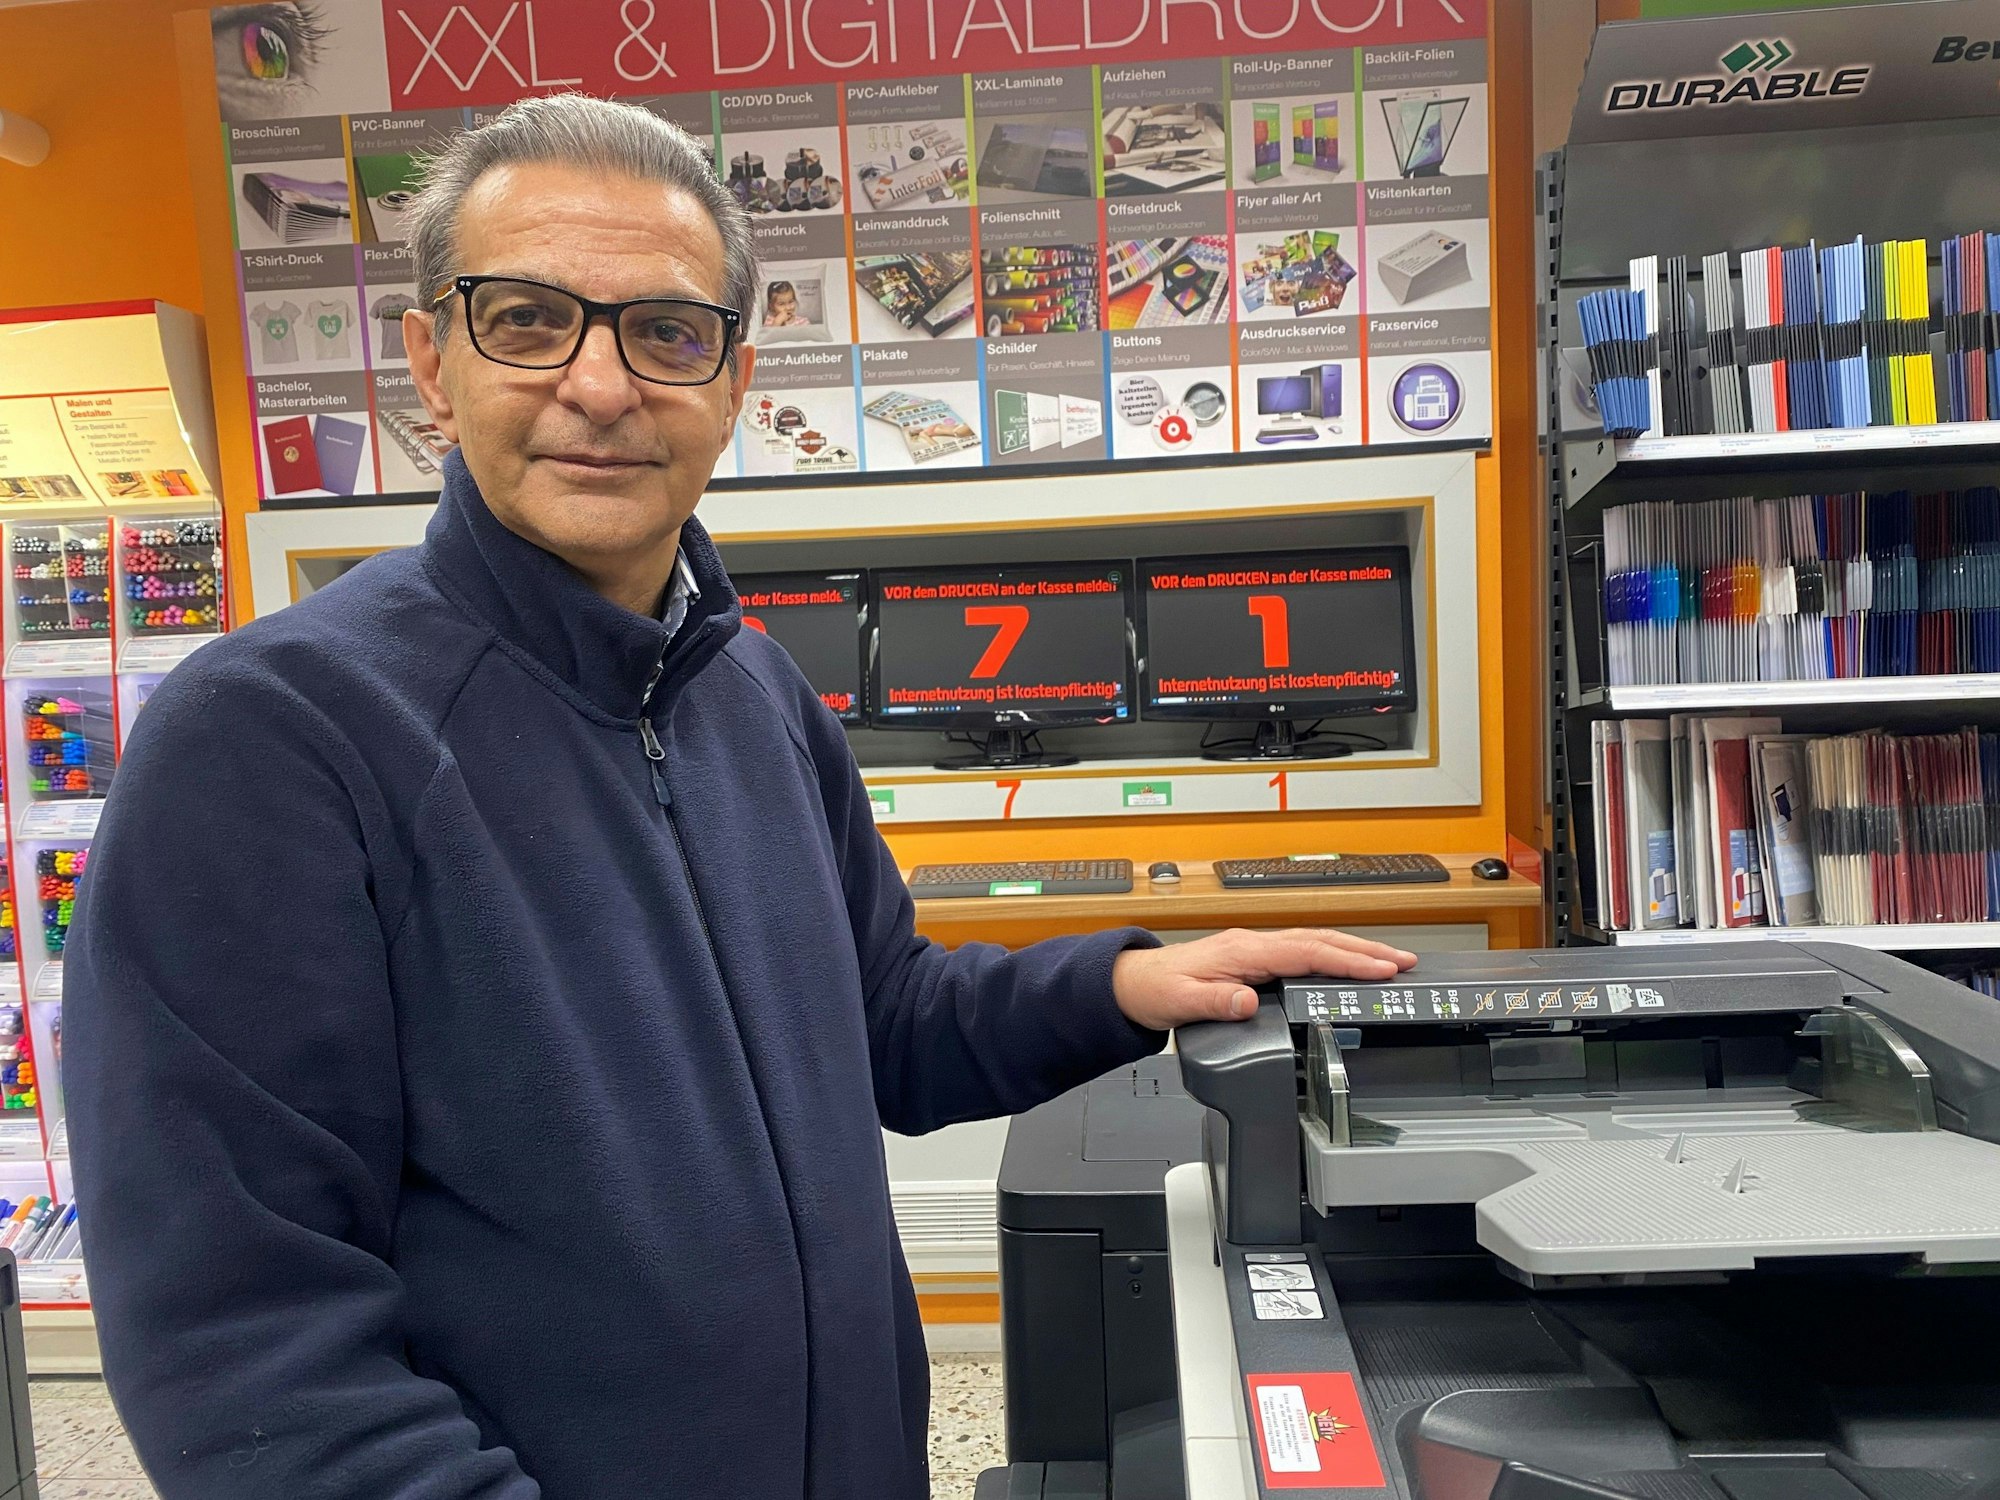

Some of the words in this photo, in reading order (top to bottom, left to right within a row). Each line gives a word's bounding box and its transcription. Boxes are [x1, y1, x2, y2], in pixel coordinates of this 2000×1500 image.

[396, 1, 583, 96] XXL
[613, 0, 678, 83] &
[1365, 48, 1455, 66] Backlit-Folien
[1233, 57, 1333, 75] Roll-Up-Banner
[974, 75, 1064, 91] XXL-Laminate
[1103, 68, 1167, 83] Aufziehen
[847, 84, 939, 100] PVC-Aufkleber
[1607, 66, 1871, 112] DURABLE
[721, 93, 774, 109] CD/DVD
[775, 91, 813, 105] Druck
[231, 125, 300, 140] Broschüren
[352, 117, 426, 132] PVC-Banner
[888, 169, 943, 200] InterFoil
[1367, 185, 1452, 200] Visitenkarten
[1108, 200, 1182, 216] Offsetdruck
[1237, 195, 1269, 210] Flyer
[1271, 193, 1299, 206] aller
[1301, 191, 1322, 204] Art
[855, 215, 950, 232] Leinwanddruck
[981, 208, 1061, 225] Folienschnitt
[754, 224, 807, 237] endruck
[244, 252, 324, 268] T-Shirt-Druck
[1240, 323, 1346, 341] Ausdruckservice
[1370, 317, 1439, 333] Faxservice
[986, 342, 1038, 355] Schilder
[1112, 335, 1162, 348] Buttons
[862, 349, 909, 362] Plakate
[257, 380, 313, 393] Bachelor,
[66, 399, 94, 408] Malen
[95, 397, 113, 406] und
[259, 394, 348, 409] Masterarbeiten
[69, 409, 113, 418] Gestalten
[1151, 575, 1179, 590] VOR
[1181, 573, 1206, 588] dem
[1207, 571, 1270, 588] DRUCKEN
[1271, 572, 1287, 585] an
[1289, 569, 1309, 584] der
[1310, 568, 1348, 583] Kasse
[1349, 566, 1392, 581] melden
[751, 592, 771, 606] der
[772, 591, 809, 605] Kasse
[809, 589, 843, 603] melde
[884, 584, 912, 601] VOR
[913, 583, 938, 599] dem
[938, 582, 999, 599] DRUCKEN
[1000, 583, 1016, 596] an
[1017, 581, 1037, 596] der
[1038, 579, 1074, 595] Kasse
[1075, 579, 1117, 594] melden
[1248, 595, 1290, 668] 1
[964, 605, 1030, 679] 7
[1158, 675, 1267, 693] Internetnutzung
[1269, 674, 1287, 689] ist
[1288, 670, 1396, 690] kostenpflichtig!
[889, 684, 995, 703] Internetnutzung
[996, 683, 1014, 700] ist
[1015, 679, 1118, 699] kostenpflichtig!
[995, 779, 1023, 819] 7
[1268, 771, 1287, 812] 1
[1306, 991, 1317, 1005] A3
[1315, 991, 1326, 1005] A4
[1338, 991, 1349, 1005] B4
[1347, 991, 1358, 1005] B5
[1380, 990, 1391, 1004] A4
[1389, 990, 1401, 1004] A5
[1403, 990, 1415, 1004] B5
[1430, 989, 1441, 1003] A5
[1317, 1414, 1336, 1435] HEY!
